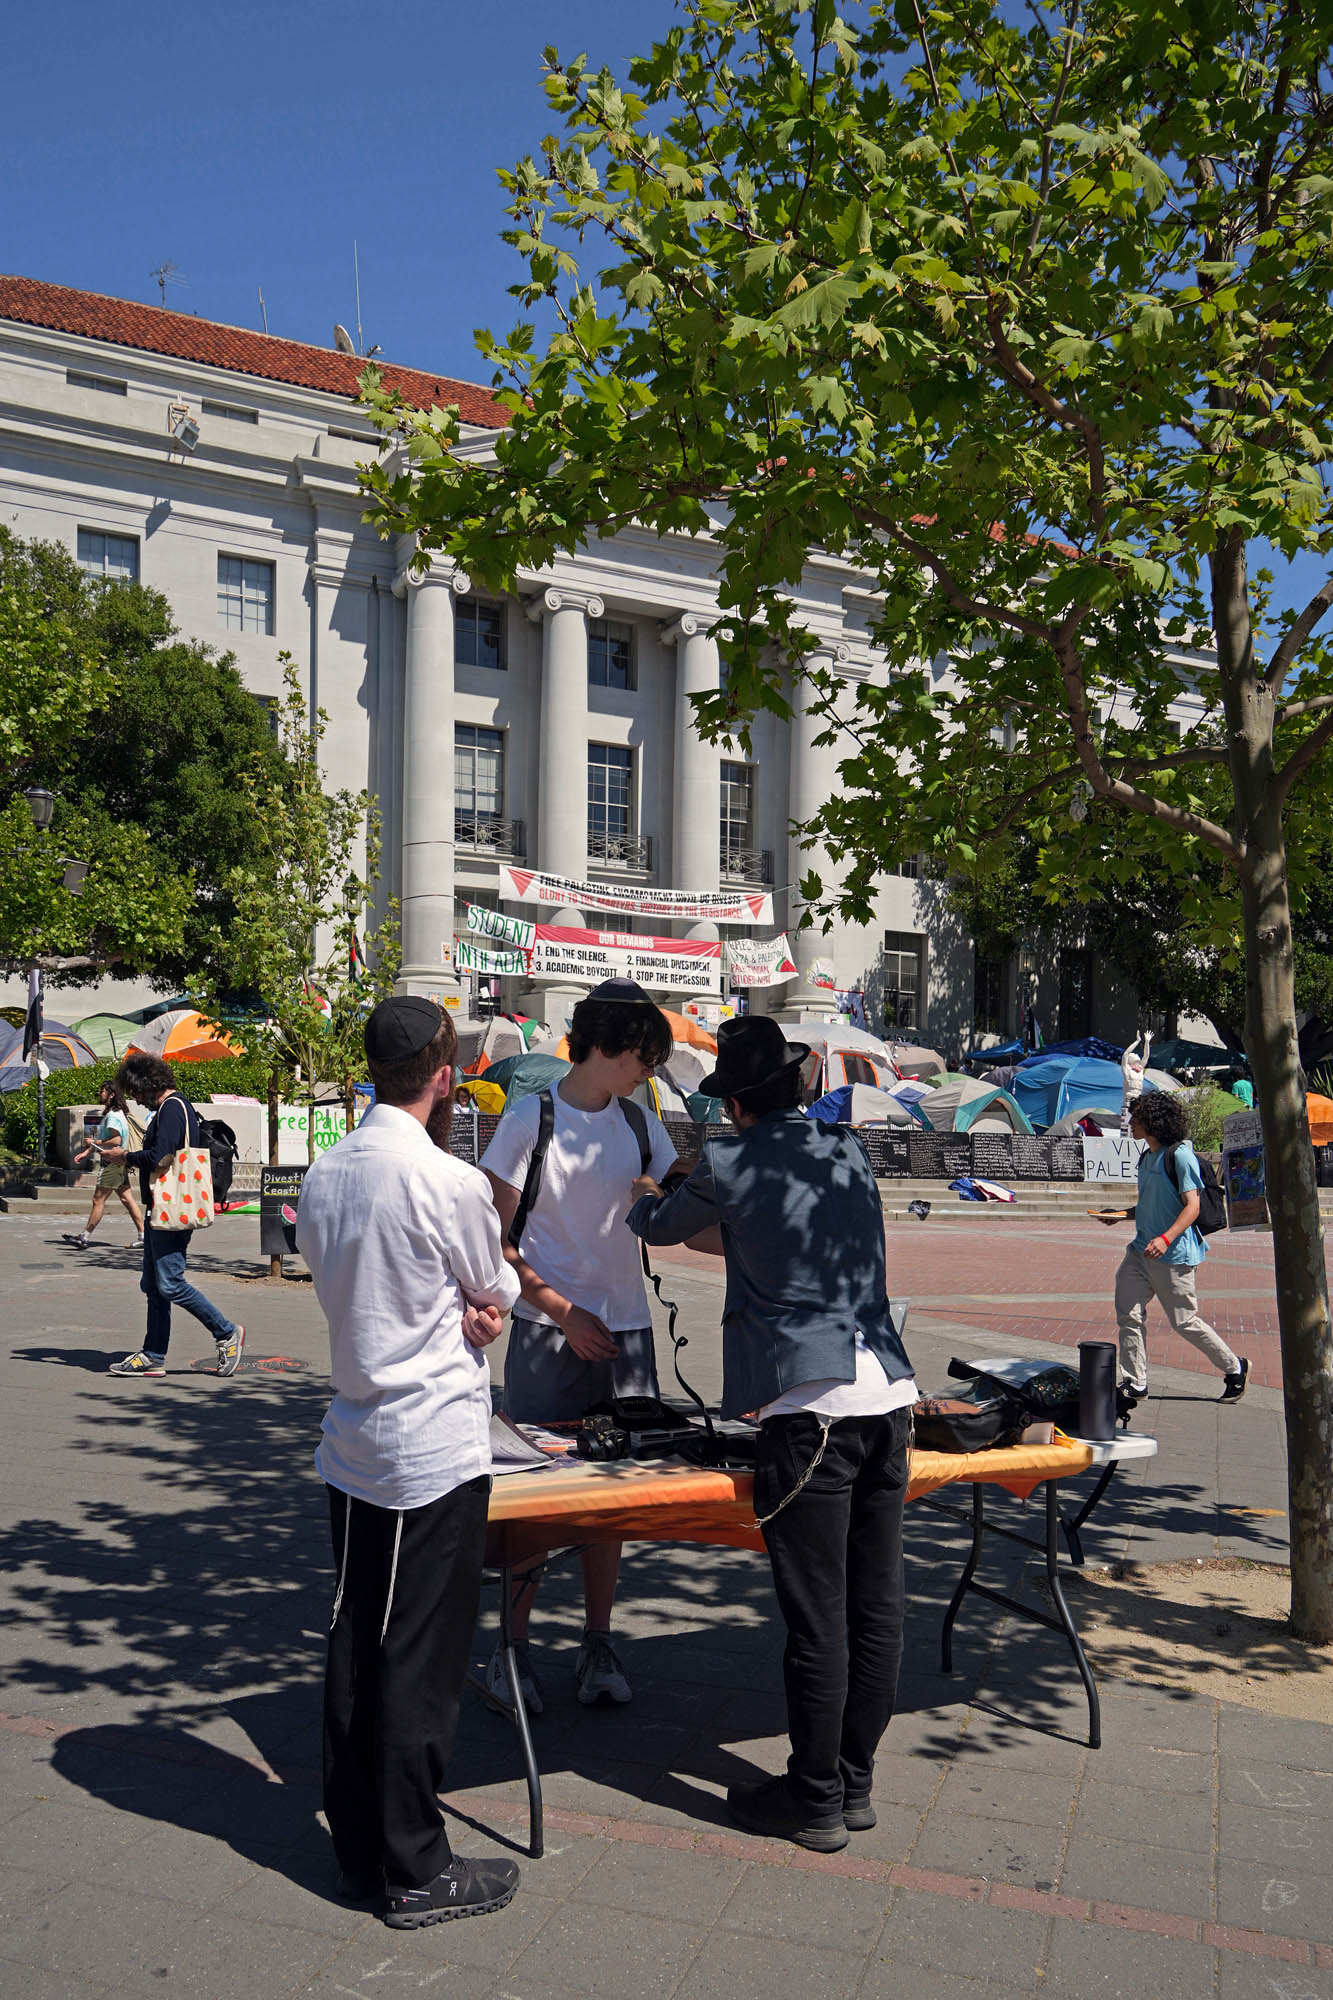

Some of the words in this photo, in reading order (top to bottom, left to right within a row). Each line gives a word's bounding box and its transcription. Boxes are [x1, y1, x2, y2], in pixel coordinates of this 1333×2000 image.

[540, 875, 561, 889] FREE
[564, 879, 612, 896] PALESTINE
[613, 886, 673, 903] ENCAMPMENT
[675, 892, 698, 904] UNTIL
[700, 894, 710, 904] UC
[539, 887, 565, 902] GLORY
[568, 891, 579, 904] TO
[580, 894, 595, 907] THE
[639, 902, 672, 915] VICTORY
[674, 905, 683, 916] TO
[685, 906, 698, 917] THE
[700, 907, 743, 919] RESISTANCE!
[467, 906, 534, 947] STUDENT
[599, 932, 615, 945] OUR
[616, 934, 654, 949] DEMANDS
[458, 941, 525, 974] INTIFADA
[536, 945, 543, 956] 1.
[545, 946, 560, 957] END
[562, 948, 576, 959] THE
[577, 949, 609, 963] SILENCE.
[535, 961, 544, 972] 3.
[546, 961, 585, 975] ACADEMIC
[586, 966, 618, 978] BOYCOTT
[626, 955, 634, 966] 2.
[636, 955, 669, 969] FINANCIAL
[670, 959, 712, 973] DIVESTMENT.
[626, 969, 634, 981] 4.
[636, 971, 654, 982] STOP
[656, 972, 669, 984] THE
[670, 973, 712, 987] REPRESSION.
[265, 1111, 307, 1131] ree
[1086, 1160, 1139, 1179] PALE
